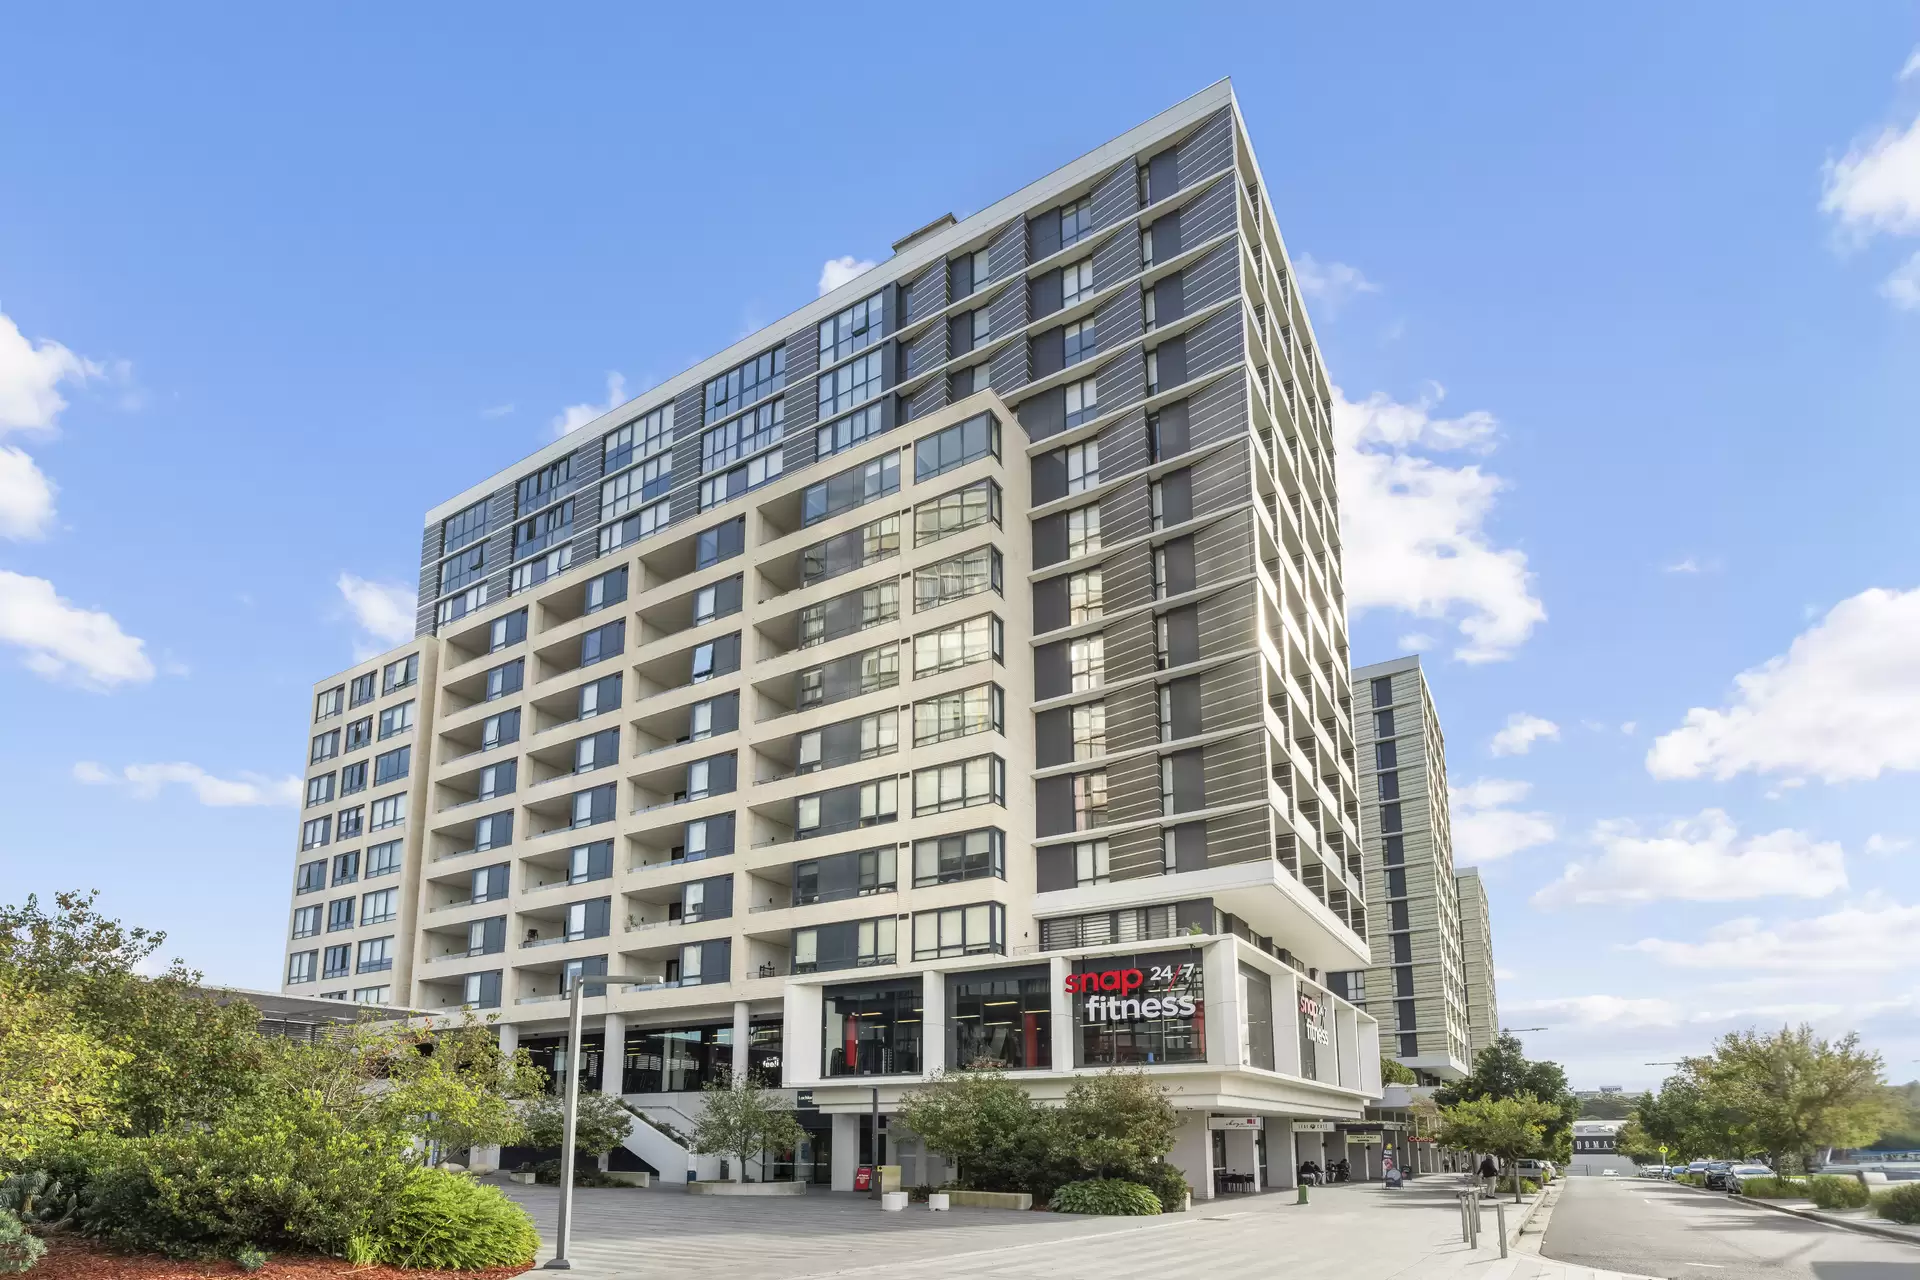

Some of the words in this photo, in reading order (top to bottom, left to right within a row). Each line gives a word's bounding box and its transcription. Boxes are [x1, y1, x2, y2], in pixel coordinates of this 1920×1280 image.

[1064, 968, 1143, 997] snap
[1150, 962, 1195, 993] 24/7
[1085, 994, 1197, 1022] fitness
[1300, 995, 1318, 1025] snap
[1306, 1018, 1329, 1046] fitness
[1576, 1140, 1617, 1149] DOMAY
